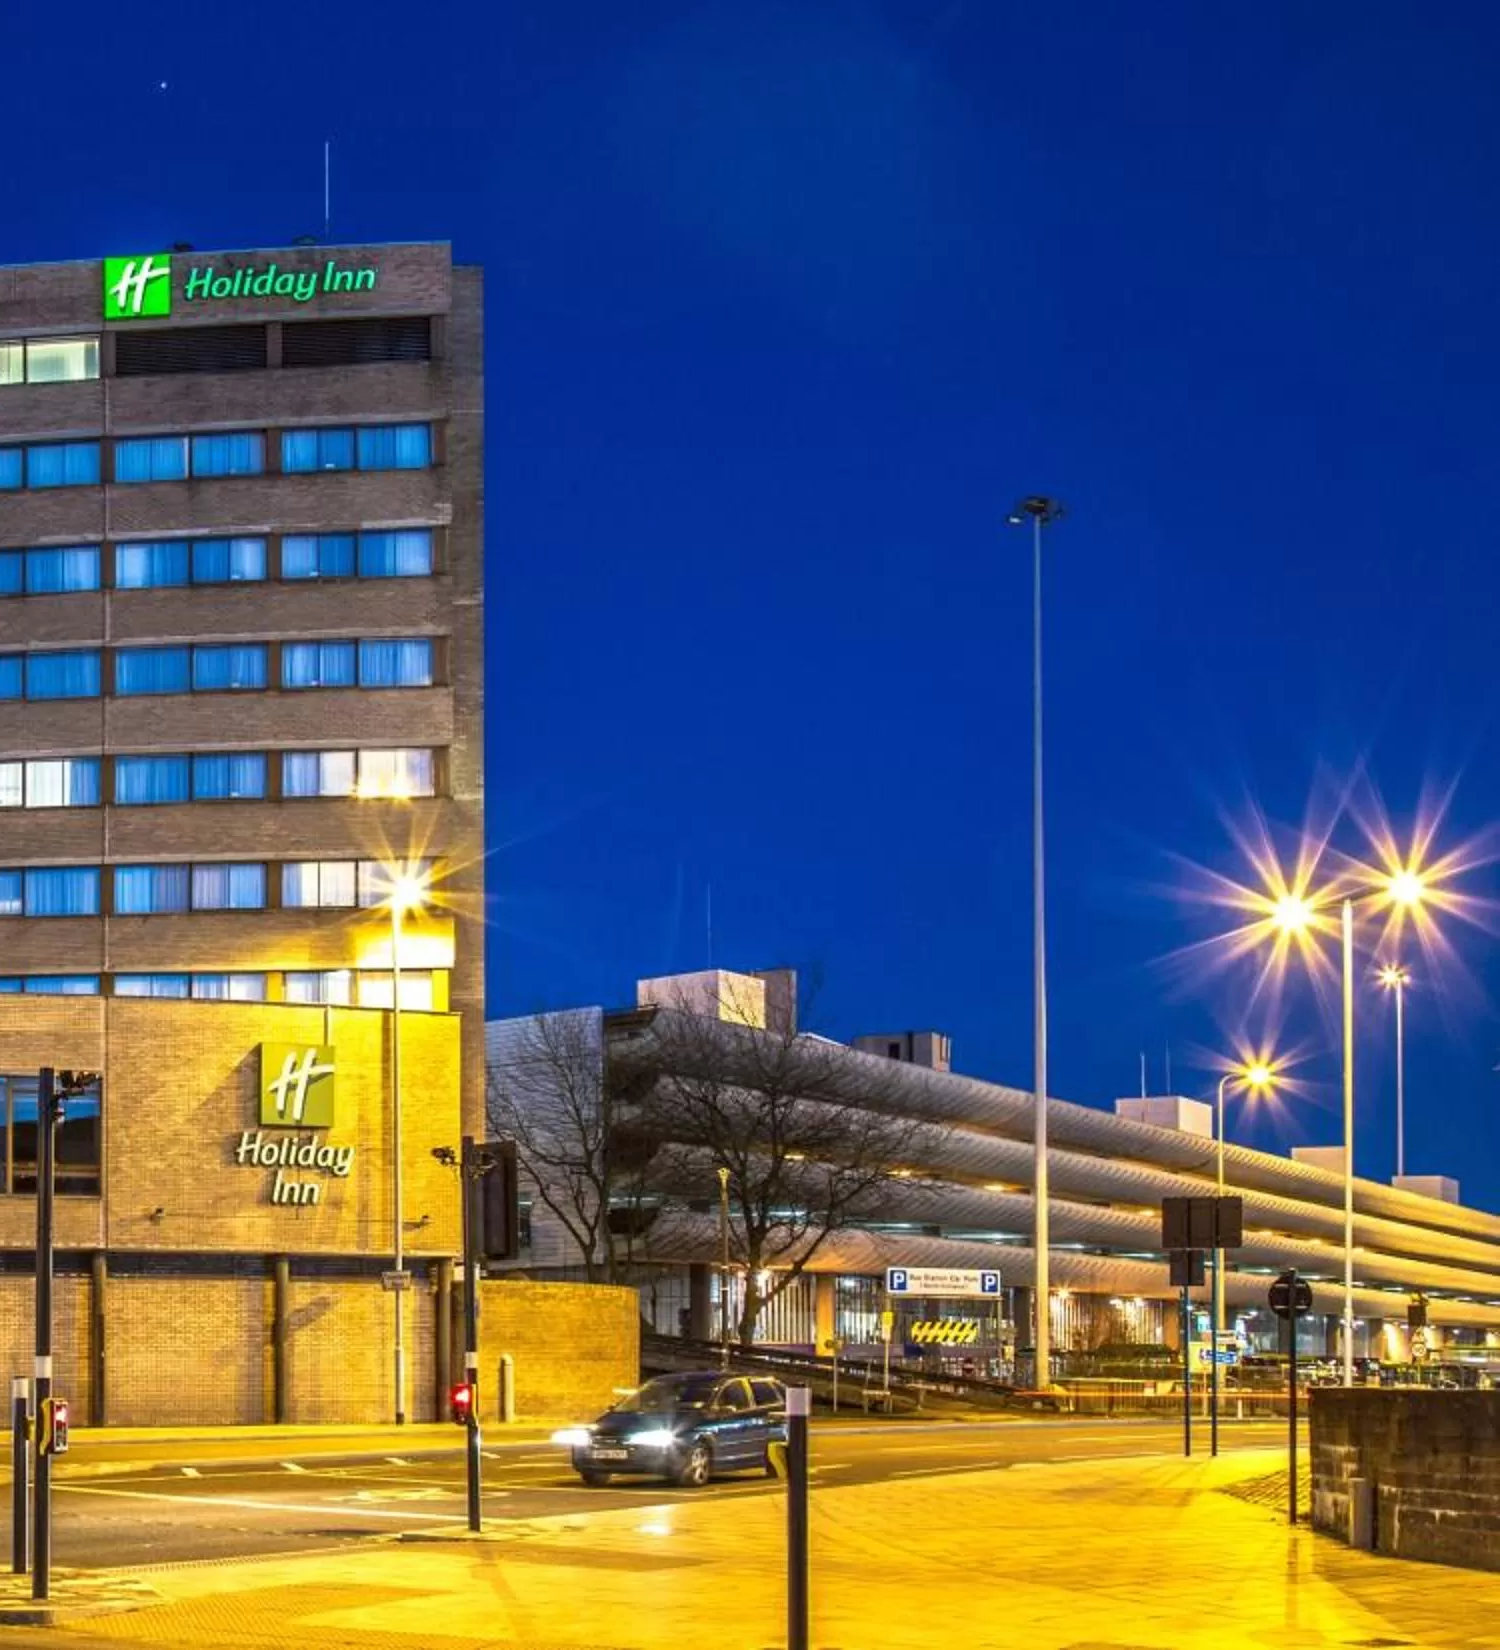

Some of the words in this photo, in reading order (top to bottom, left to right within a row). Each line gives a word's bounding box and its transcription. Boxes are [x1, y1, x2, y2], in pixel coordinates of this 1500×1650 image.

[185, 263, 318, 301] Holiday
[323, 261, 376, 292] Inn
[236, 1131, 356, 1176] Holiday
[272, 1168, 320, 1204] Inn
